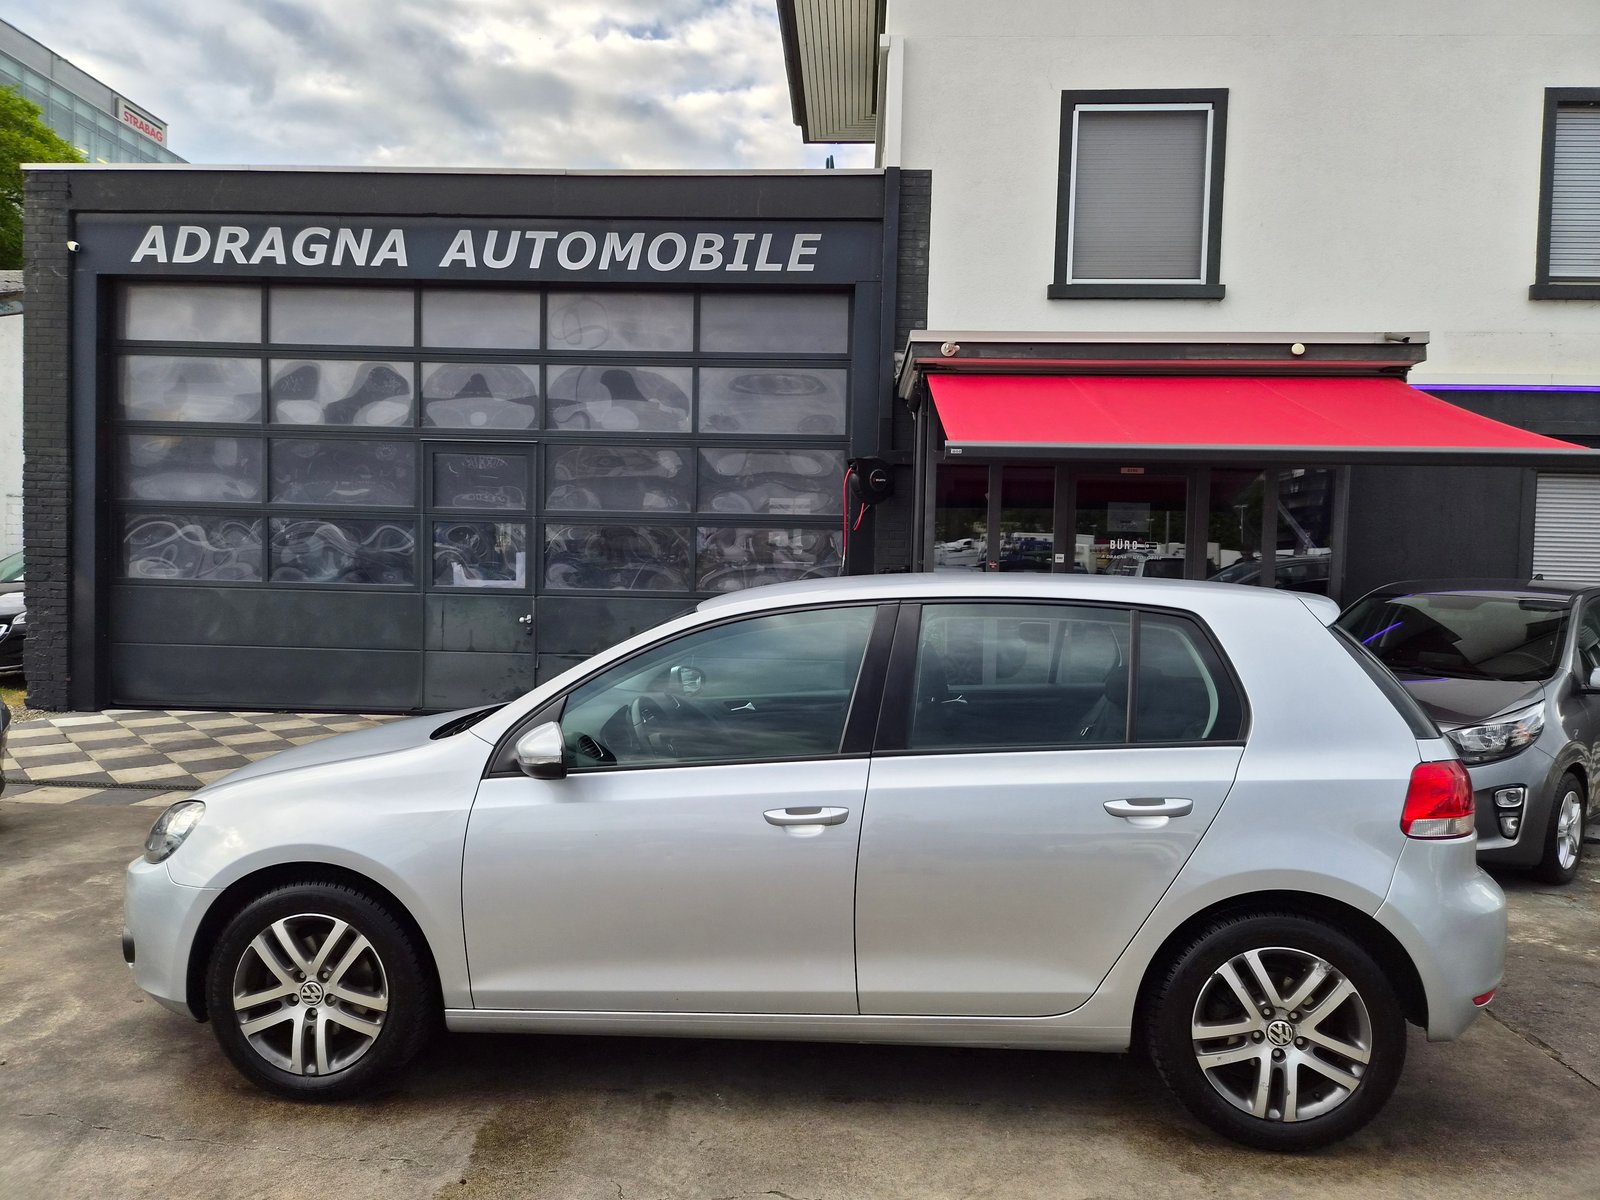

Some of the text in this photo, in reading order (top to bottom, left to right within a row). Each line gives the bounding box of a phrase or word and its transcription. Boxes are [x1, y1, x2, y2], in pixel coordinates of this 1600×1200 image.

[123, 110, 163, 142] STRABAG
[130, 225, 823, 272] ADRAGNA AUTOMOBILE
[1109, 538, 1138, 550] BÜRO
[1267, 1020, 1294, 1046] VW
